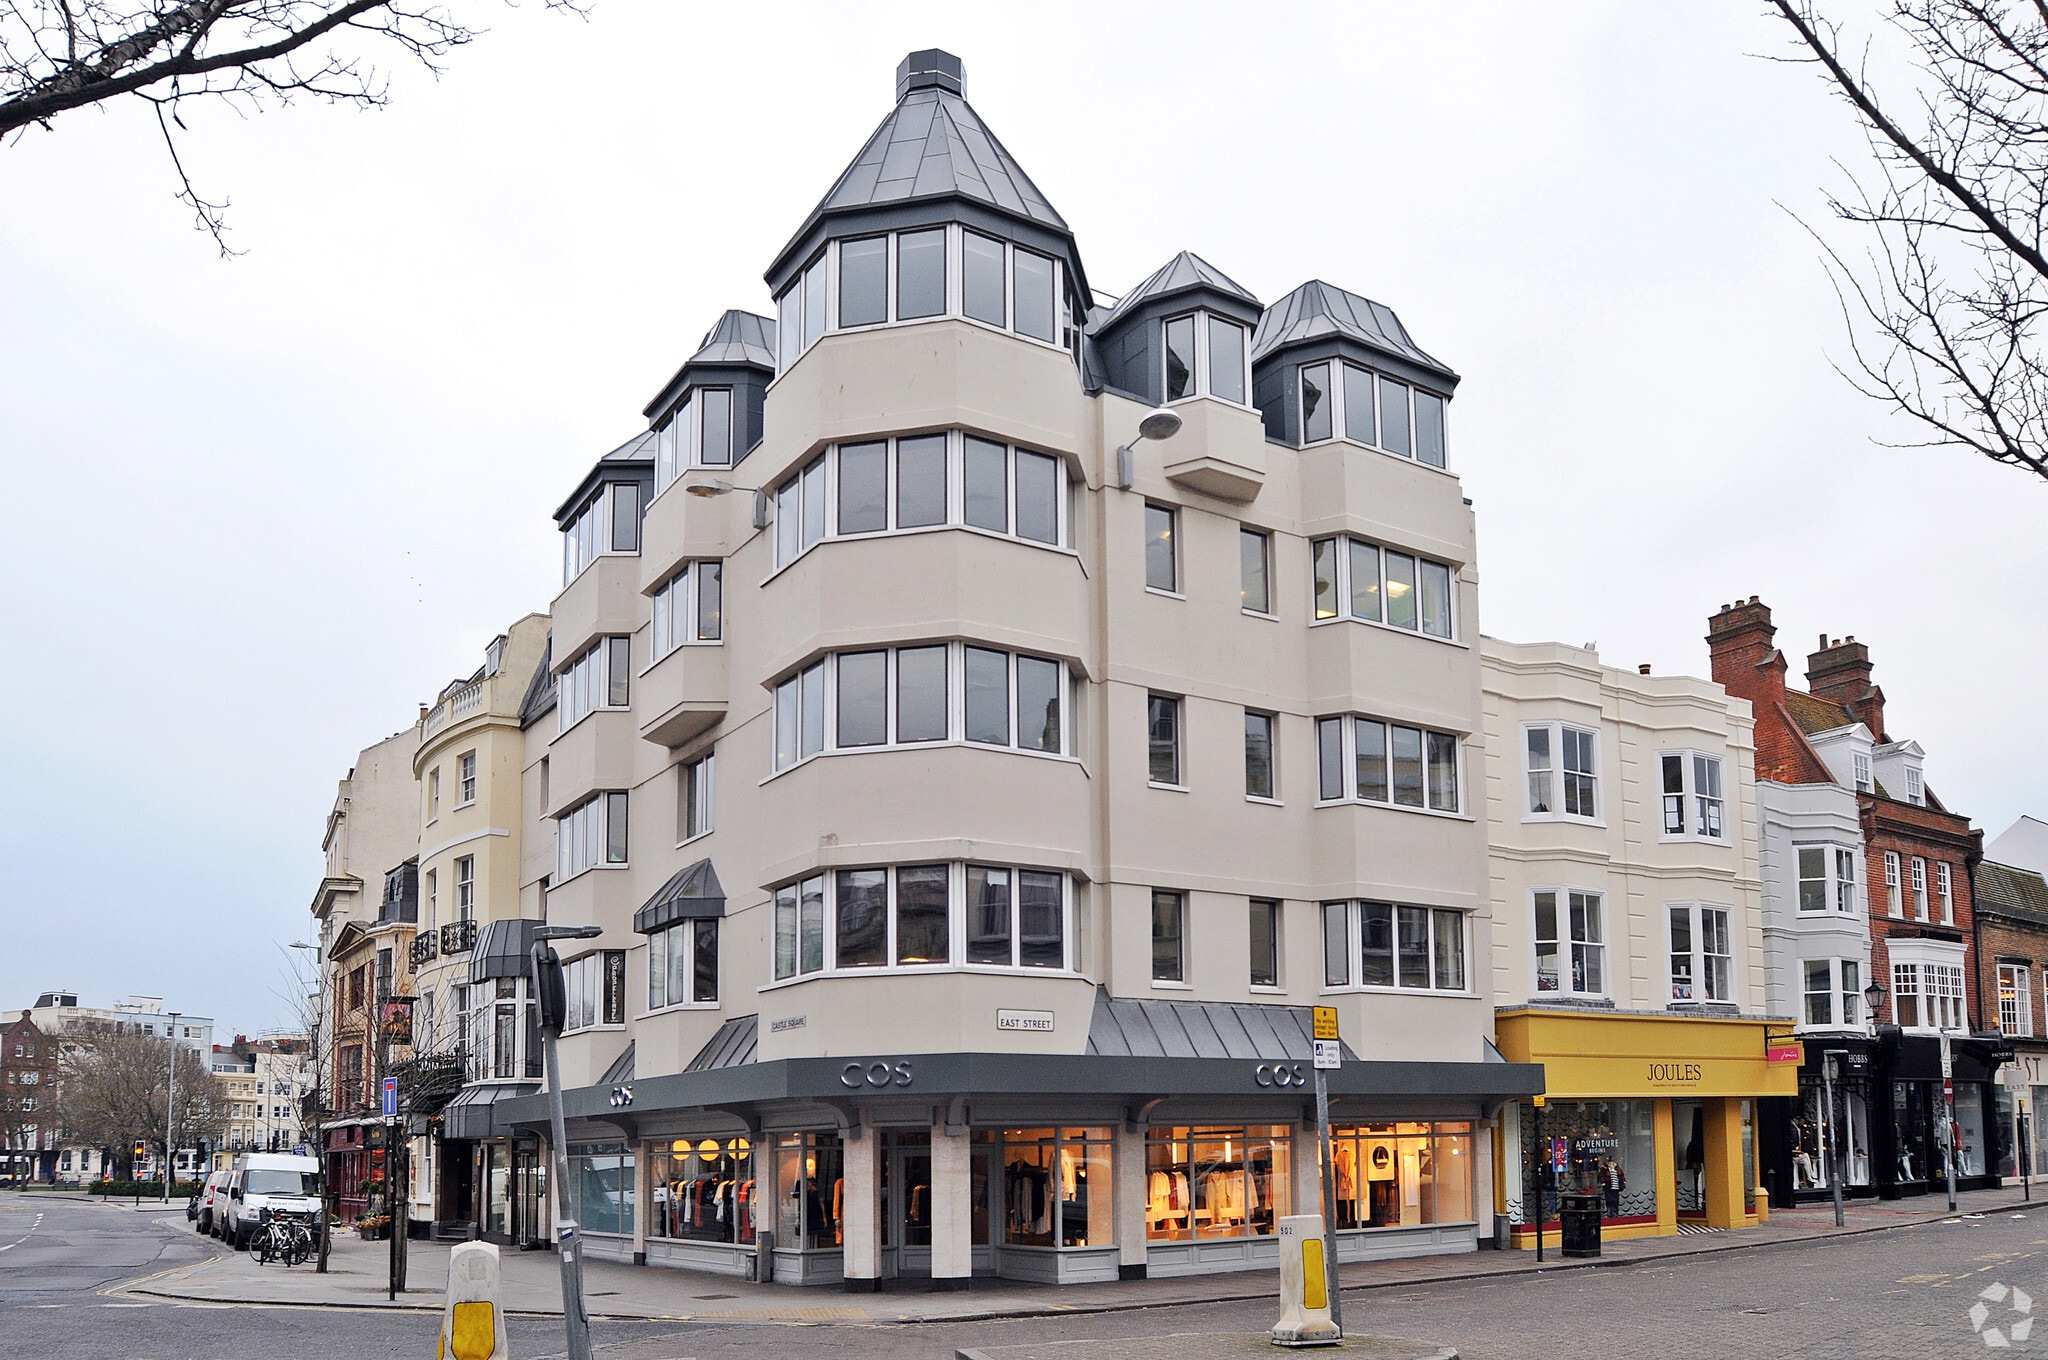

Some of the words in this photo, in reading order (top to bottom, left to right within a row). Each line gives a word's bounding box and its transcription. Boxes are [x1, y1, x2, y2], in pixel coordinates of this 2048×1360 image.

[772, 1021, 786, 1030] CASTLE
[788, 1017, 804, 1027] SQUARE
[1000, 1018, 1020, 1028] EAST
[1023, 1019, 1051, 1029] STREET
[1848, 1054, 1868, 1064] HOBBS
[840, 1061, 913, 1089] COS
[1255, 1064, 1306, 1088] COS
[1647, 1063, 1702, 1081] JOULES
[609, 1085, 633, 1107] COS
[1575, 1139, 1619, 1148] ADVENTURE
[1280, 1226, 1293, 1235] 502
